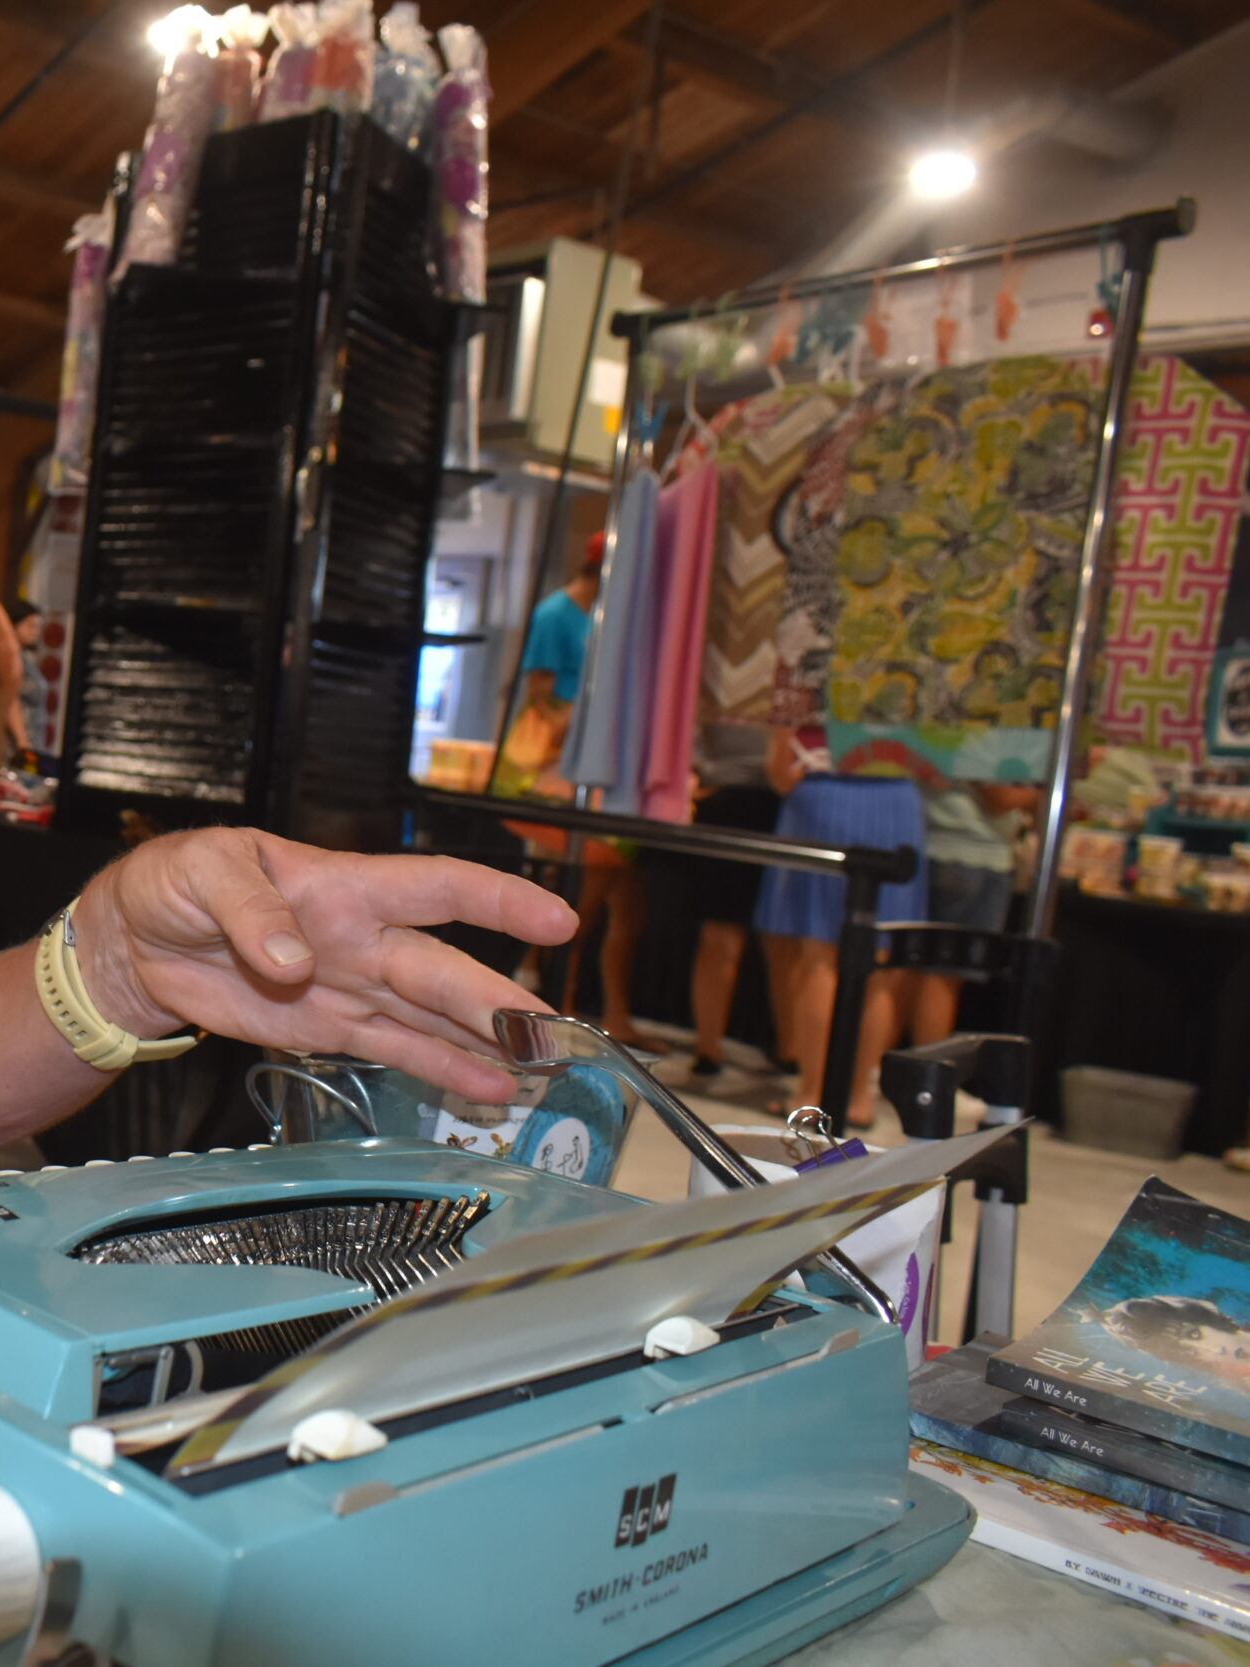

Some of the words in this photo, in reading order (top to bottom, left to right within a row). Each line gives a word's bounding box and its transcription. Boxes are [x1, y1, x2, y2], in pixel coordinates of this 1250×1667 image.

[1024, 1378, 1039, 1390] All
[1042, 1383, 1061, 1399] We
[1064, 1390, 1087, 1407] Are
[1040, 1427, 1055, 1440] All
[1058, 1431, 1077, 1448] We
[1081, 1440, 1104, 1457] Are
